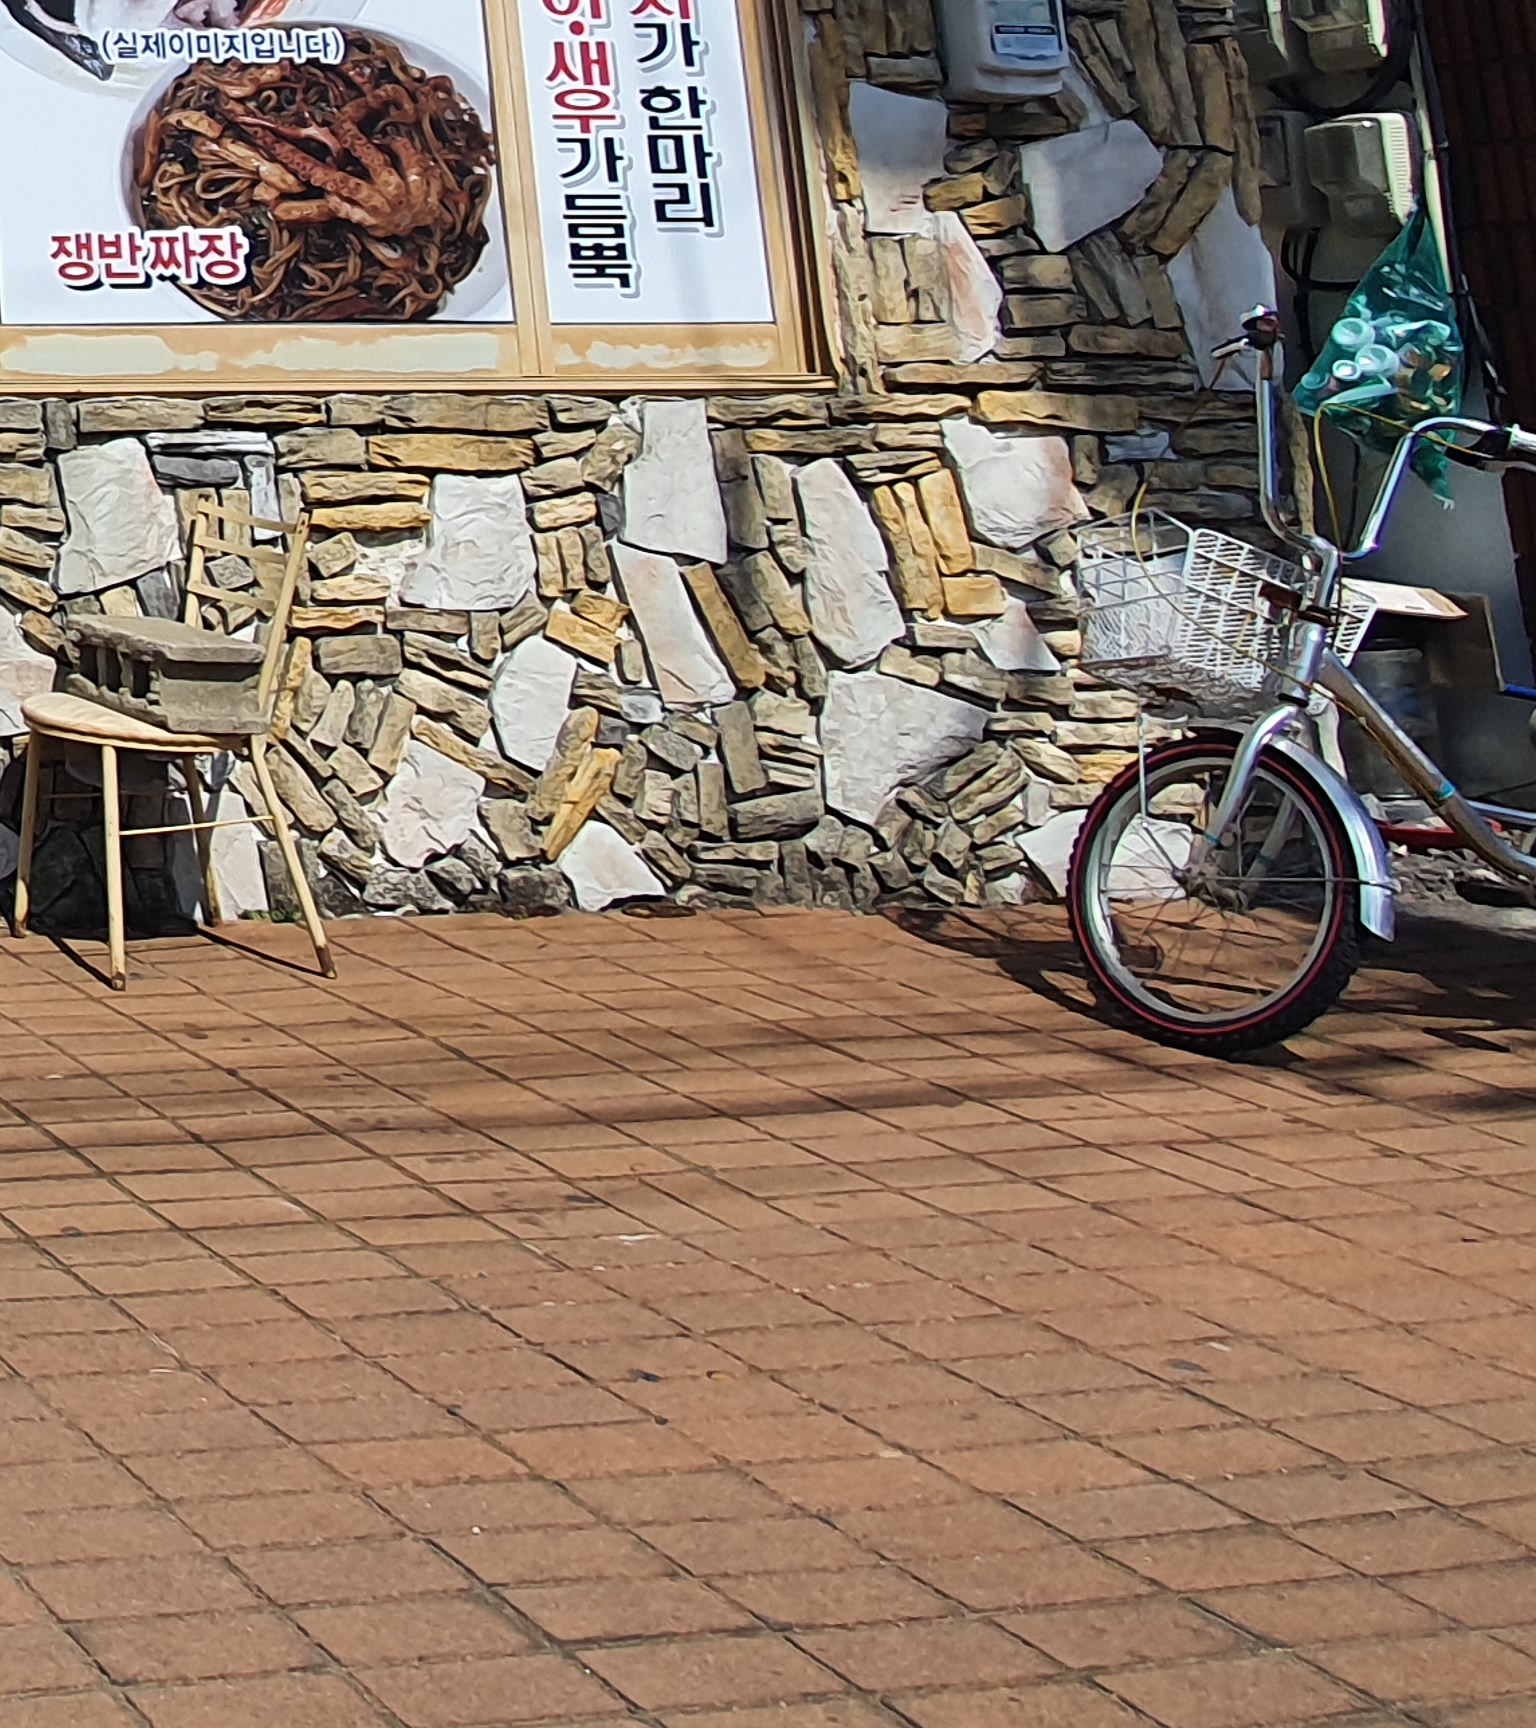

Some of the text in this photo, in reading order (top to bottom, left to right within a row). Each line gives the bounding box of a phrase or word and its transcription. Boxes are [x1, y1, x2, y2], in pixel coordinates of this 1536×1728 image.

[101, 28, 346, 62] (실제이미지입니다)
[637, 83, 716, 230] 한마리
[561, 192, 634, 290] 듬뿍
